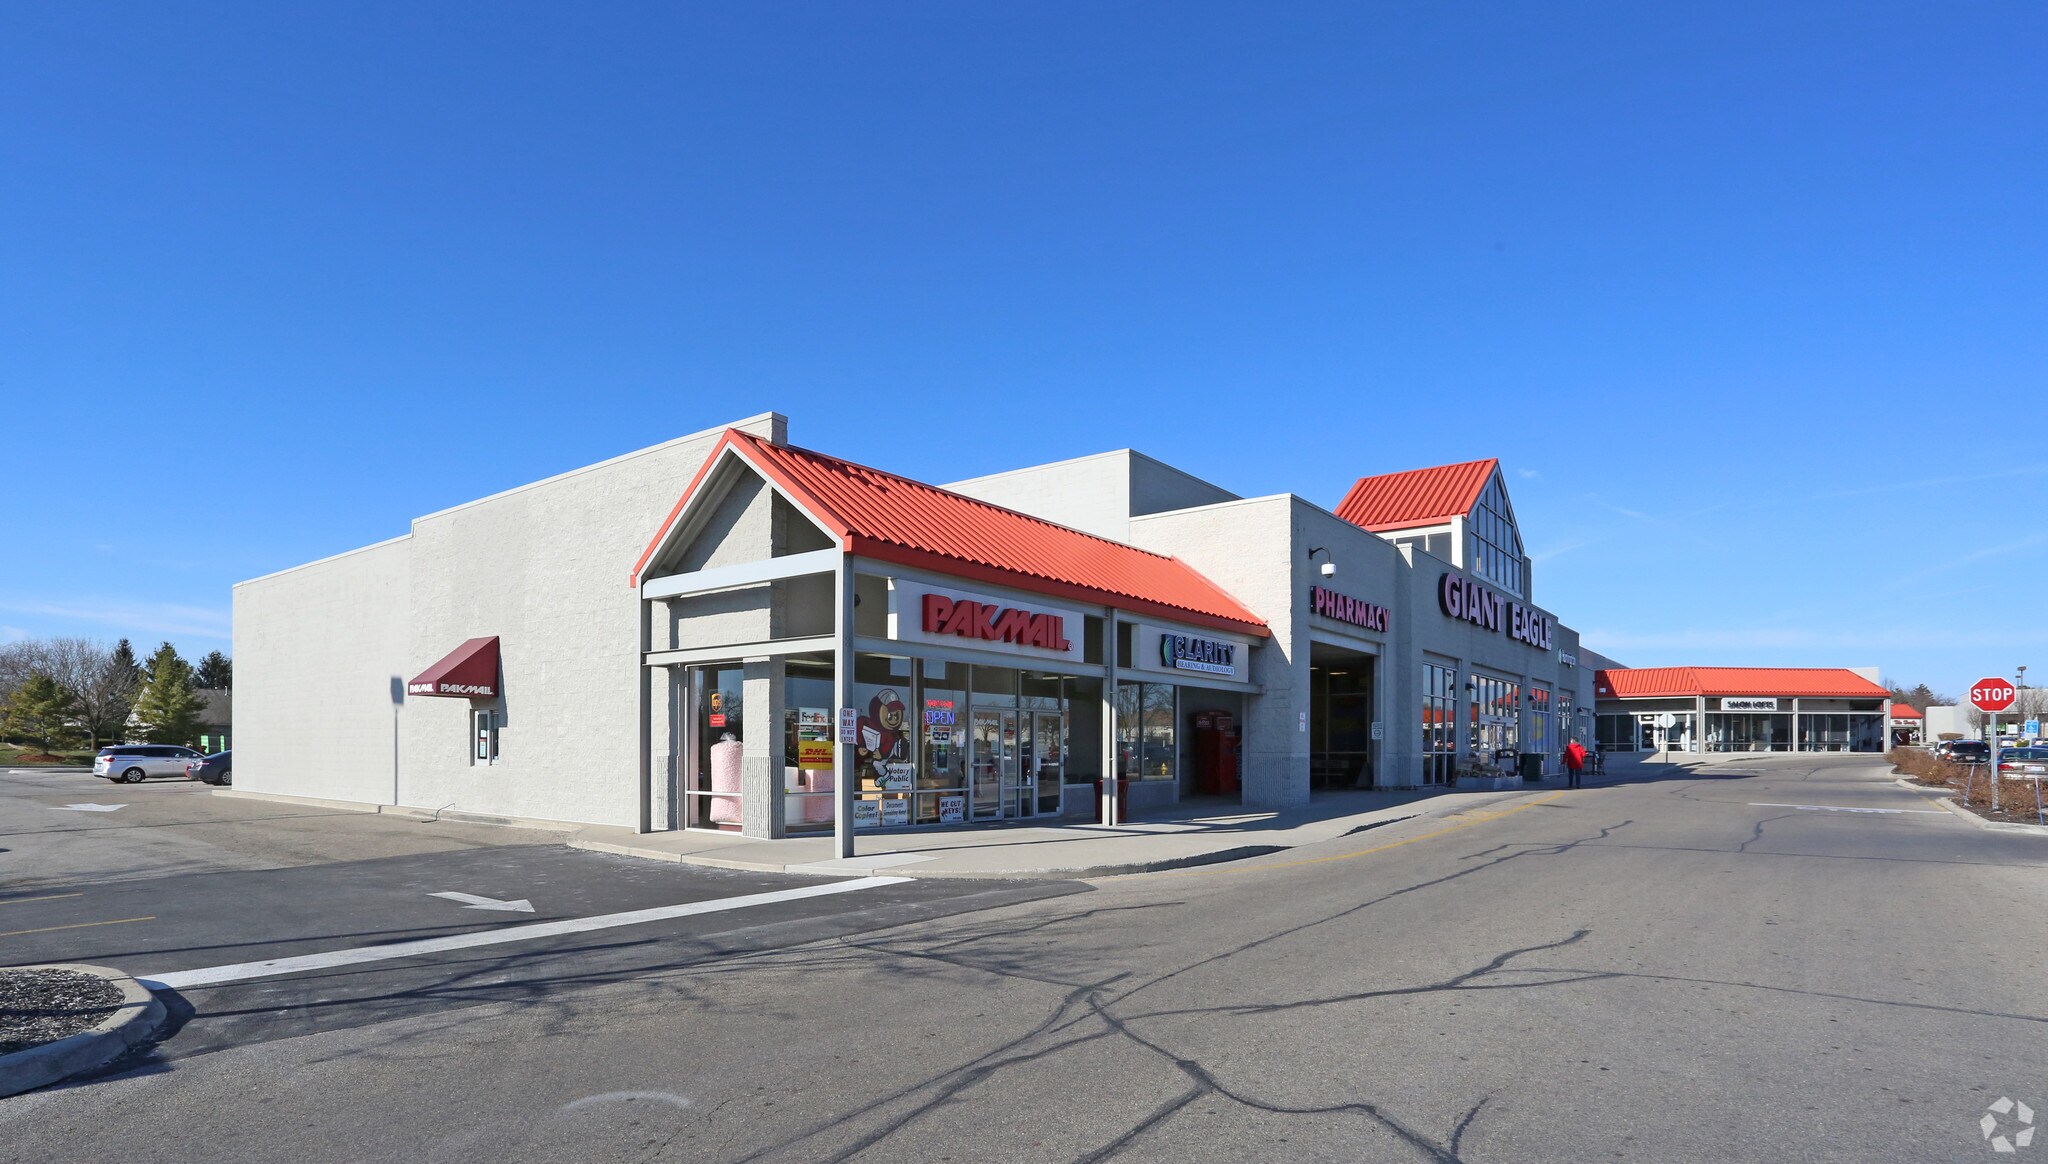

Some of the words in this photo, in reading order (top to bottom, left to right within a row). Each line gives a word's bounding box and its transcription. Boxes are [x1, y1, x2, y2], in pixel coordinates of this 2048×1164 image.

[1312, 586, 1391, 633] PHARMACY
[1439, 572, 1505, 632] GIANT
[1509, 603, 1552, 650] EAGLE
[1174, 635, 1237, 666] CLARITY
[1177, 660, 1201, 670] HEARING
[1200, 663, 1206, 671] &
[1206, 665, 1234, 675] AUDIOLOGY
[1972, 688, 2013, 702] STOP
[1727, 701, 1752, 709] SALON
[1753, 701, 1776, 709] LOFTS
[801, 711, 826, 723] FedEx
[842, 709, 854, 718] ONE
[925, 710, 955, 725] OPEN
[842, 719, 855, 727] WAY
[804, 748, 828, 756] DHL
[888, 767, 910, 776] Notary
[857, 804, 875, 812] Color
[941, 800, 949, 808] WE
[854, 811, 878, 820] Copies!
